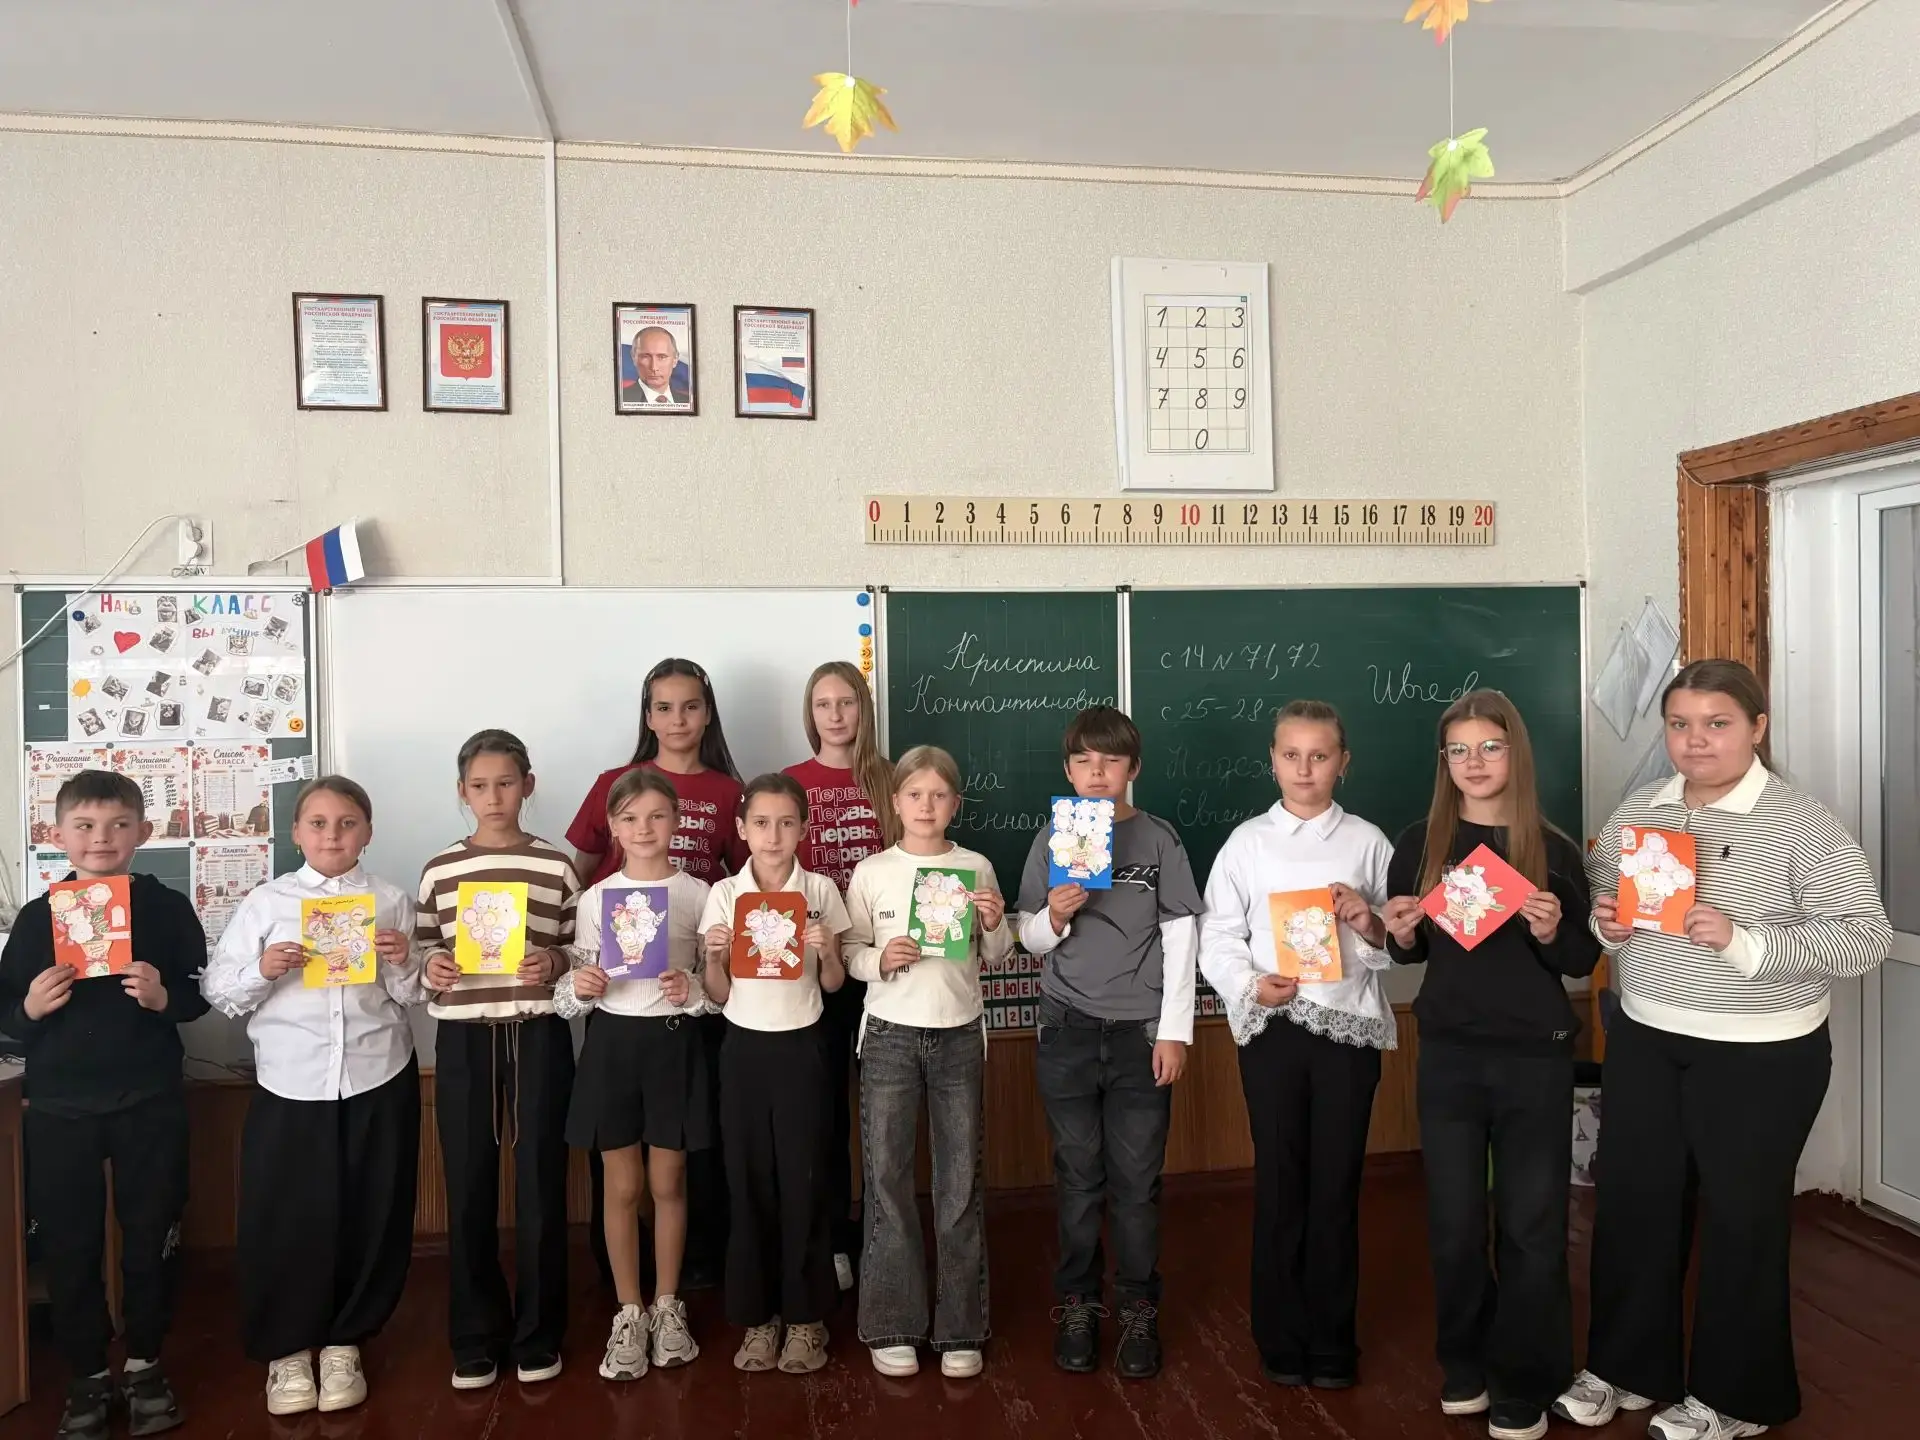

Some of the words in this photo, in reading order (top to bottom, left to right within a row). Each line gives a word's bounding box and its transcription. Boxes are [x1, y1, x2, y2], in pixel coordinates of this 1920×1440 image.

[1157, 306, 1168, 328] 1
[1195, 306, 1206, 328] 2
[1232, 307, 1244, 328] 3
[1156, 347, 1168, 368] 4
[1194, 348, 1207, 368] 5
[1233, 348, 1246, 368] 6
[1158, 388, 1169, 410] 7
[1195, 388, 1208, 409] 8
[1234, 388, 1246, 409] 9
[1195, 428, 1208, 450] 0
[869, 501, 880, 522] 0
[904, 501, 910, 523] 1
[935, 502, 944, 524] 2
[966, 502, 976, 524] 3
[996, 503, 1006, 524] 4
[1030, 504, 1039, 524] 5
[1060, 504, 1070, 524] 6
[1093, 504, 1102, 524] 7
[1123, 504, 1132, 524] 8
[1154, 504, 1163, 524] 9
[1180, 504, 1200, 525] 10
[1212, 504, 1225, 524] 11
[1242, 504, 1258, 525] 12
[1272, 504, 1288, 525] 13
[1302, 504, 1318, 525] 14
[1334, 504, 1350, 526] 15
[1362, 504, 1378, 526] 16
[1392, 505, 1408, 526] 17
[1421, 505, 1436, 526] 18
[1449, 506, 1464, 526] 19
[1474, 506, 1493, 526] 20
[100, 594, 137, 613] На
[194, 594, 272, 614] КЛАСС
[192, 628, 214, 638] ВЫ
[943, 631, 1101, 686] Кристина
[46, 754, 92, 762] Расписание
[214, 749, 246, 759] Список
[1008, 958, 1016, 970] У
[1032, 956, 1044, 969] Ы
[982, 985, 988, 998] Я
[994, 980, 1001, 996] Ё
[1006, 982, 1017, 996] Ю
[1022, 982, 1028, 994] Е
[1202, 1000, 1213, 1010] 16
[996, 1012, 1001, 1024] 1
[1010, 1011, 1016, 1022] 2
[1024, 1010, 1030, 1021] 3
